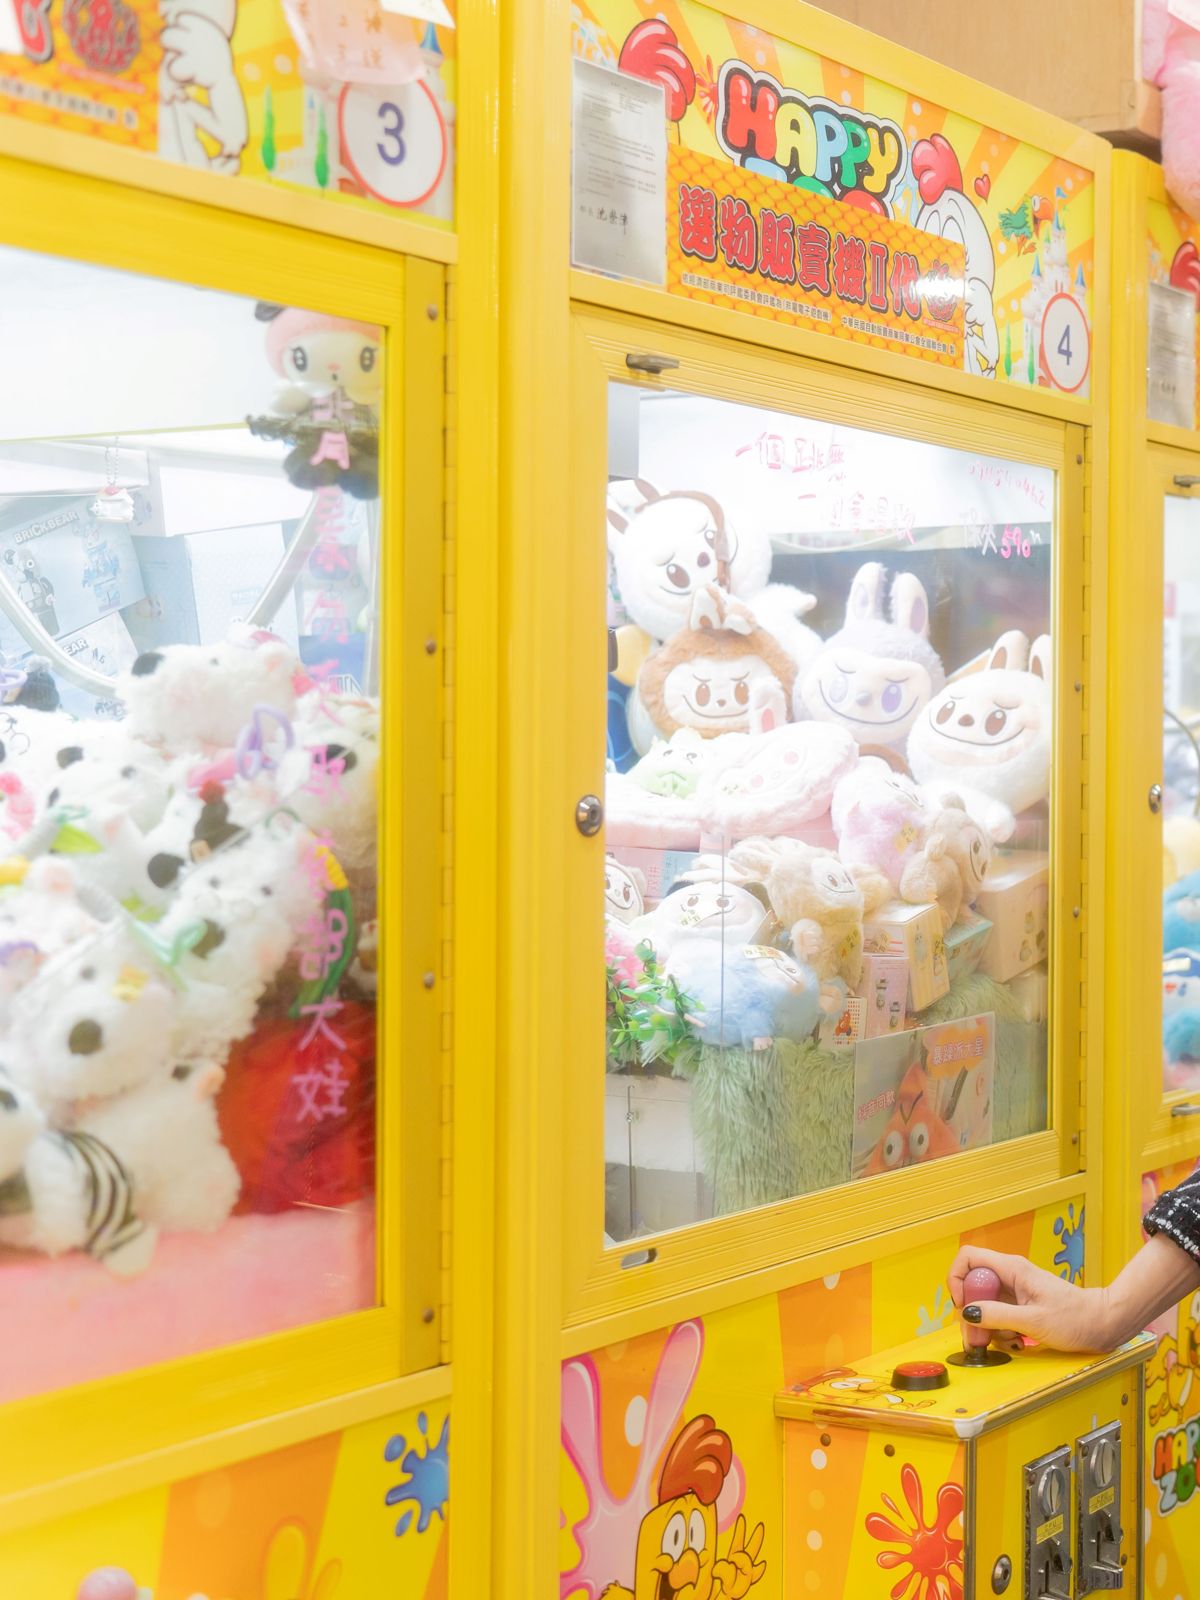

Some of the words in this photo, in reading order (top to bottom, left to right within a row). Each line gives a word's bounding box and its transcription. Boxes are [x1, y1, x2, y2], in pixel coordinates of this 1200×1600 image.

[377, 102, 406, 166] 3
[726, 71, 900, 194] HAPPY
[1057, 324, 1074, 366] 4
